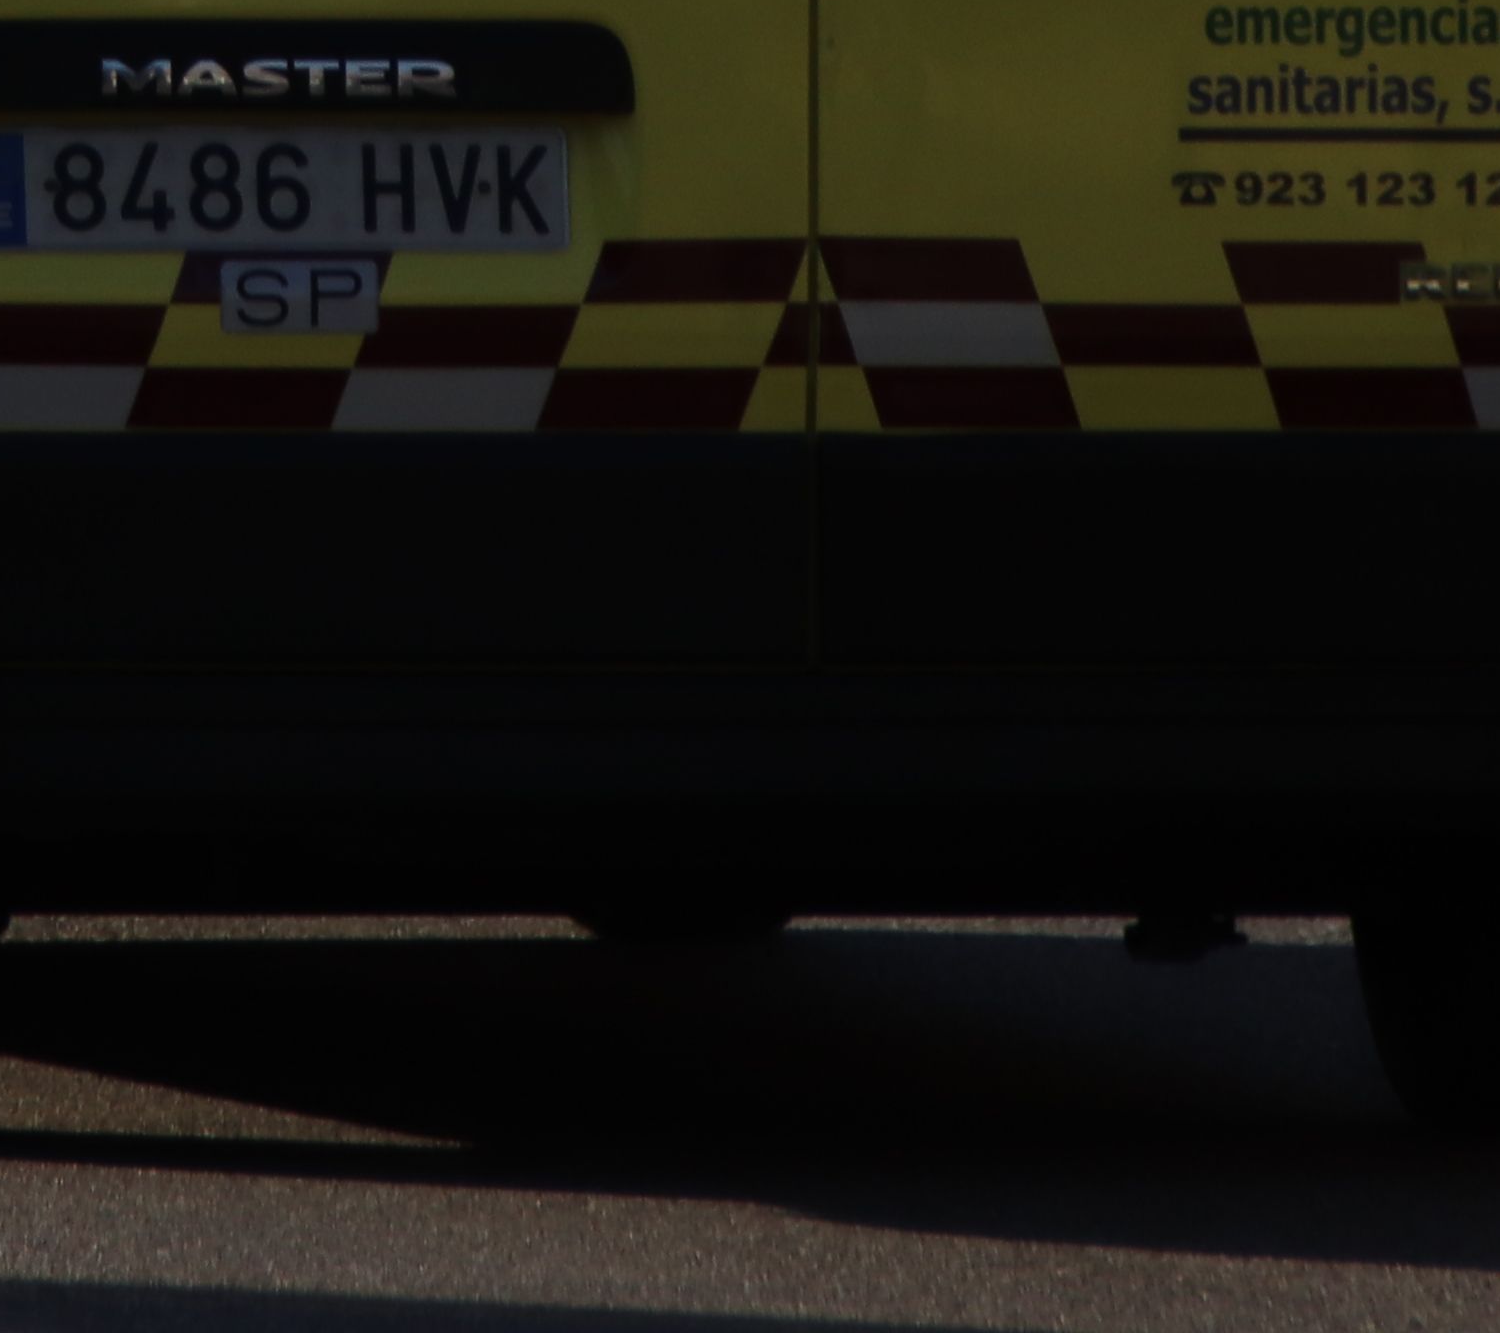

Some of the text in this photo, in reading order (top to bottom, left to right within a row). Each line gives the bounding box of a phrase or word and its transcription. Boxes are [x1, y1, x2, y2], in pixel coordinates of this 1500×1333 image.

[101, 58, 457, 98] MASTER
[1187, 63, 1450, 124] sanitarias,
[49, 141, 551, 234] 8486 HVK
[1233, 171, 1327, 207] 923
[1345, 171, 1436, 207] 123
[235, 268, 363, 328] SP
